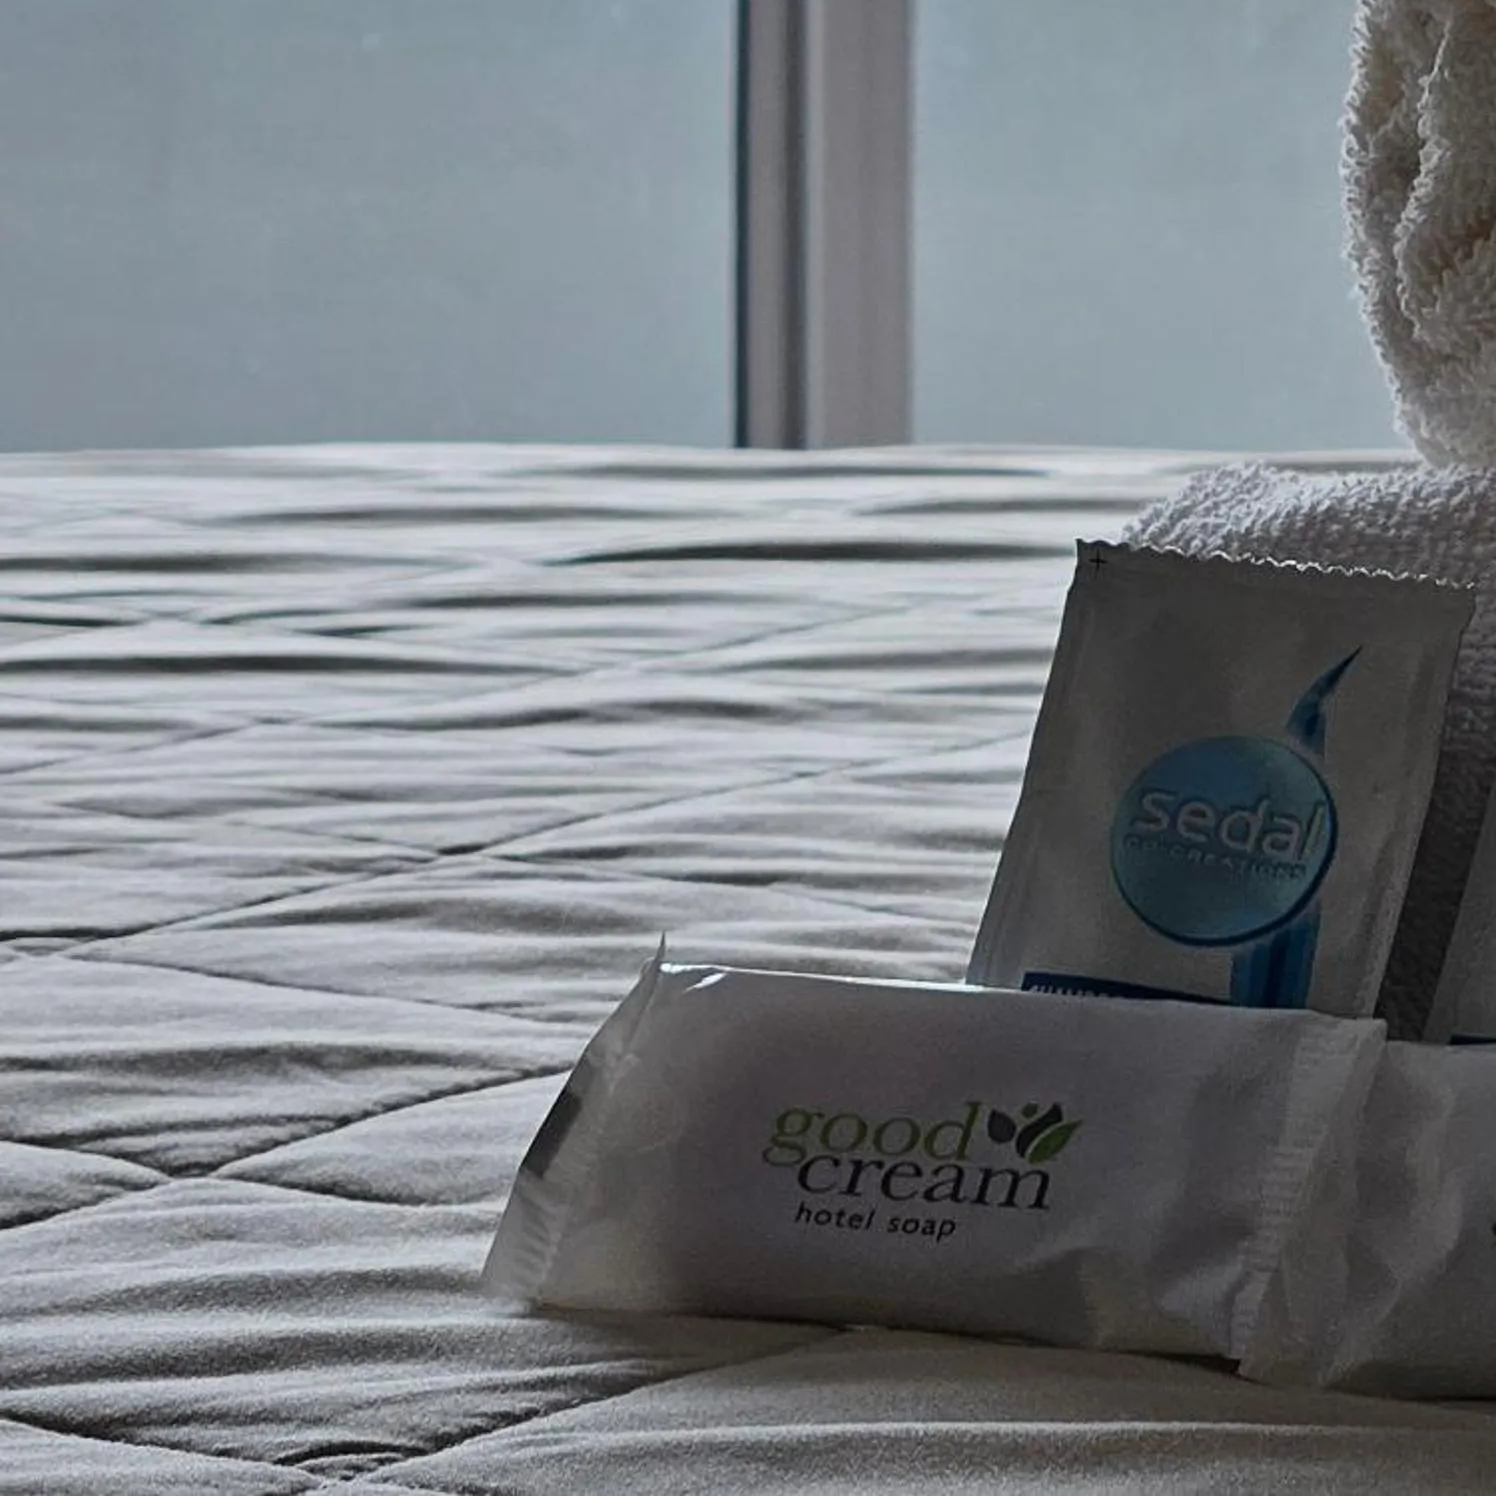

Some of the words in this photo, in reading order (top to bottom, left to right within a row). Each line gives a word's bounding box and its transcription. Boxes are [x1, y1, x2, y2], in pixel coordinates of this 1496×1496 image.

[1129, 788, 1325, 863] sedal
[762, 1101, 982, 1166] good
[797, 1154, 1051, 1210] cream
[795, 1201, 876, 1231] hotel
[887, 1214, 956, 1242] soap
